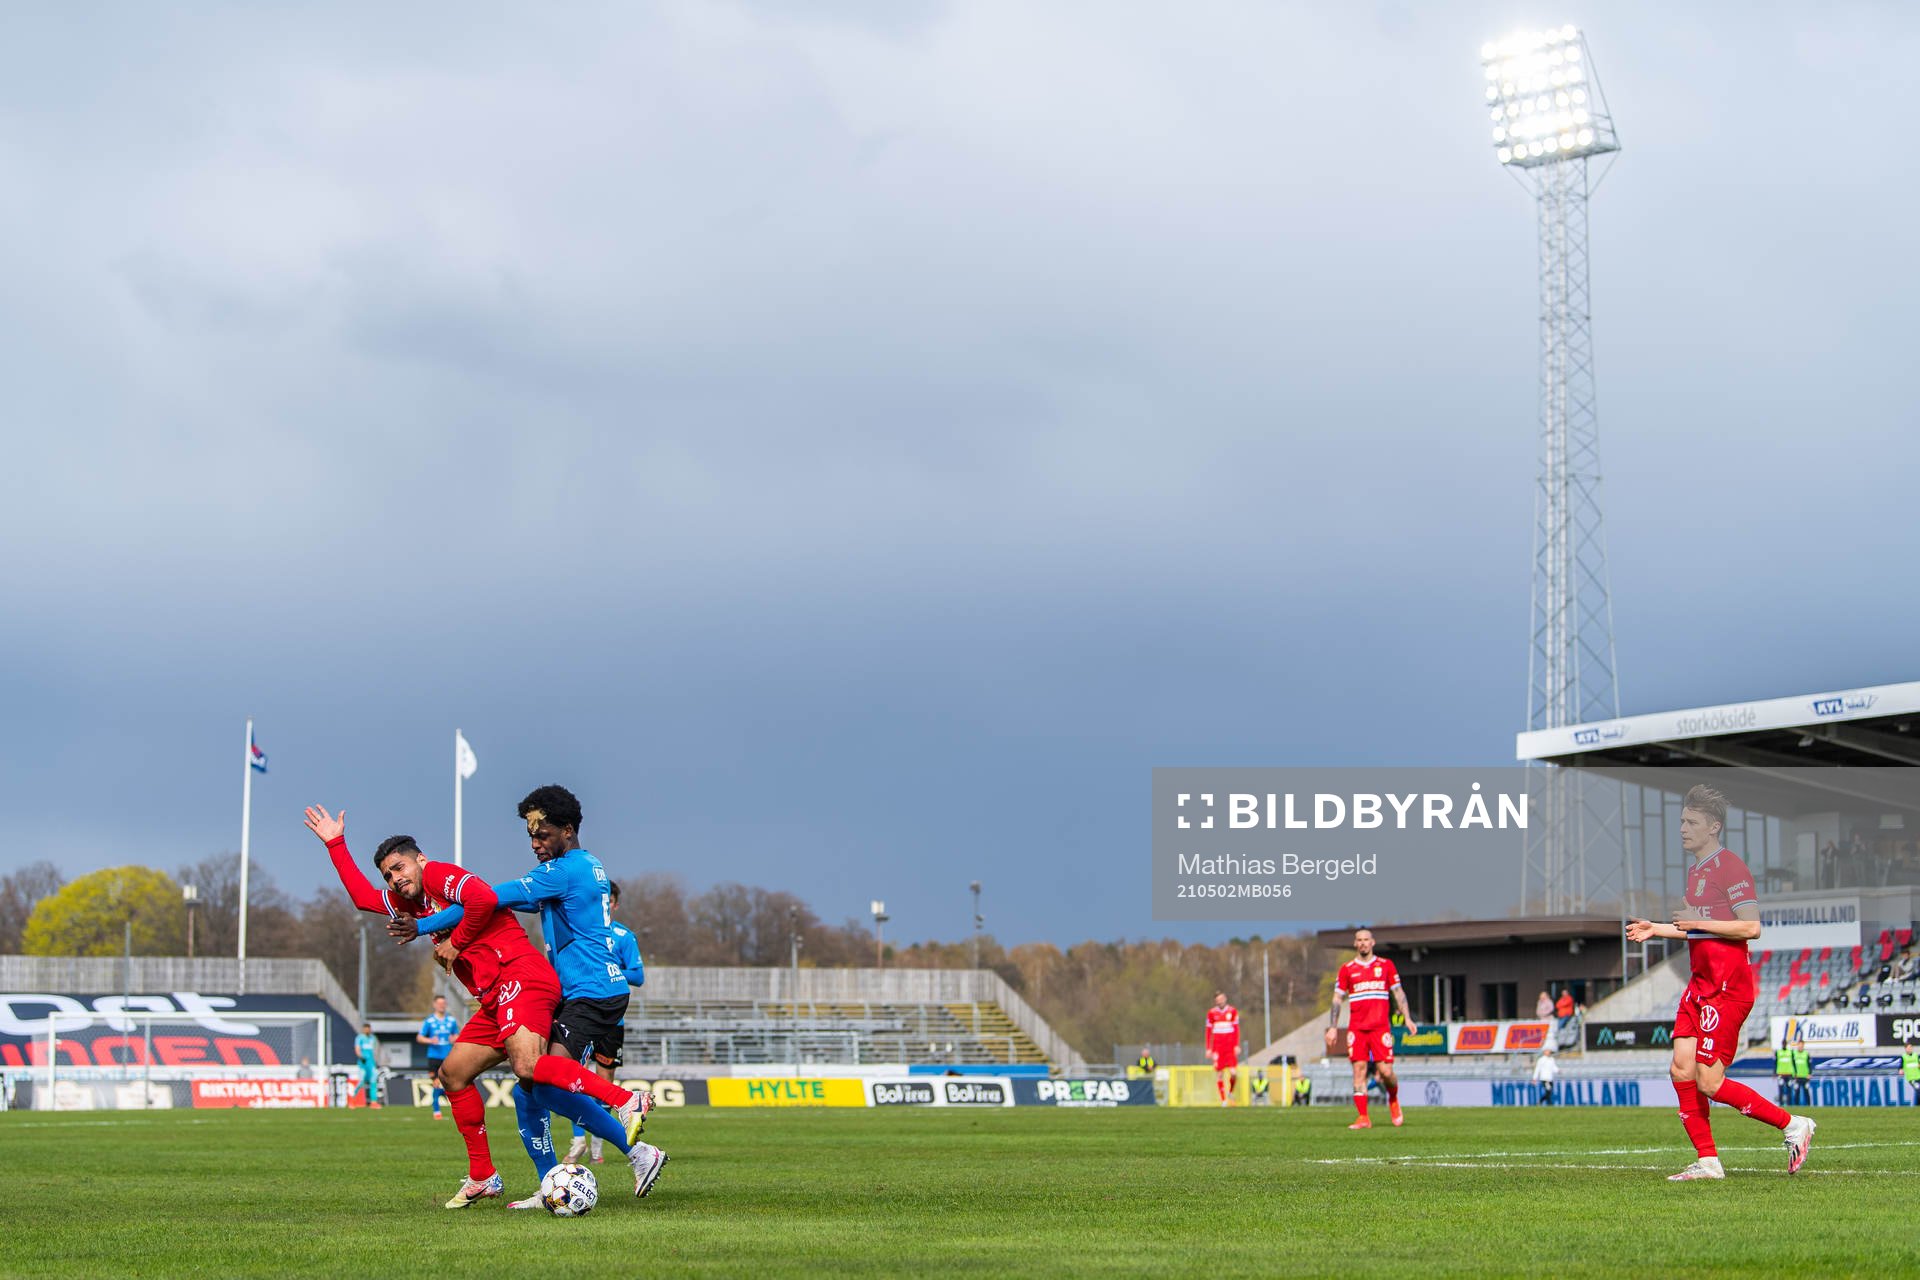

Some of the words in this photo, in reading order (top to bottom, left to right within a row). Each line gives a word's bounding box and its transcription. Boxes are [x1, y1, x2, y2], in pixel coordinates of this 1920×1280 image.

[506, 1008, 514, 1021] 8
[1808, 1023, 1838, 1038] Buss
[1840, 1021, 1860, 1038] AB
[1702, 1037, 1714, 1050] 20
[748, 1081, 825, 1099] HYLTE
[1037, 1080, 1130, 1101] PREFAB
[531, 1136, 543, 1151] GN
[572, 1180, 597, 1201] SELECT
